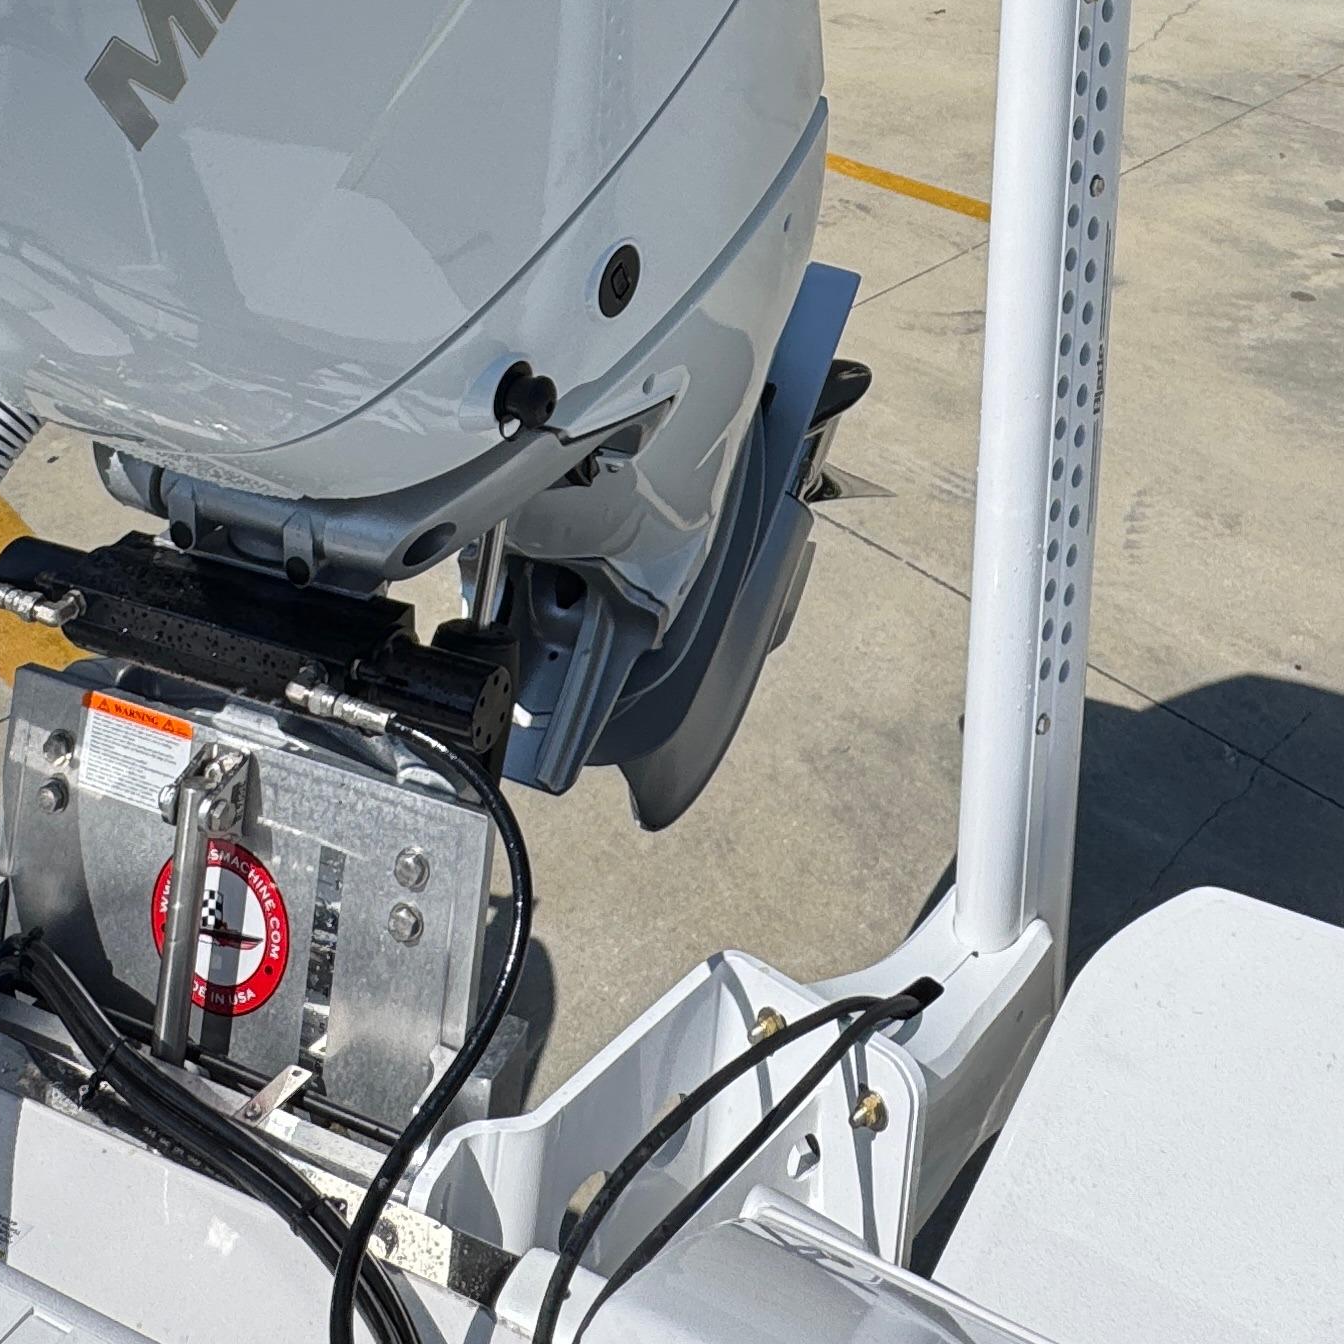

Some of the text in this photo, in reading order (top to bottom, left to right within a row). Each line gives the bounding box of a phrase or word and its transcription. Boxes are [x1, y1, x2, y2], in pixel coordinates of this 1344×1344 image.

[1093, 344, 1104, 415] Blade
[114, 703, 159, 725] WARNING
[210, 991, 225, 1005] IN
[228, 988, 257, 1005] USA
